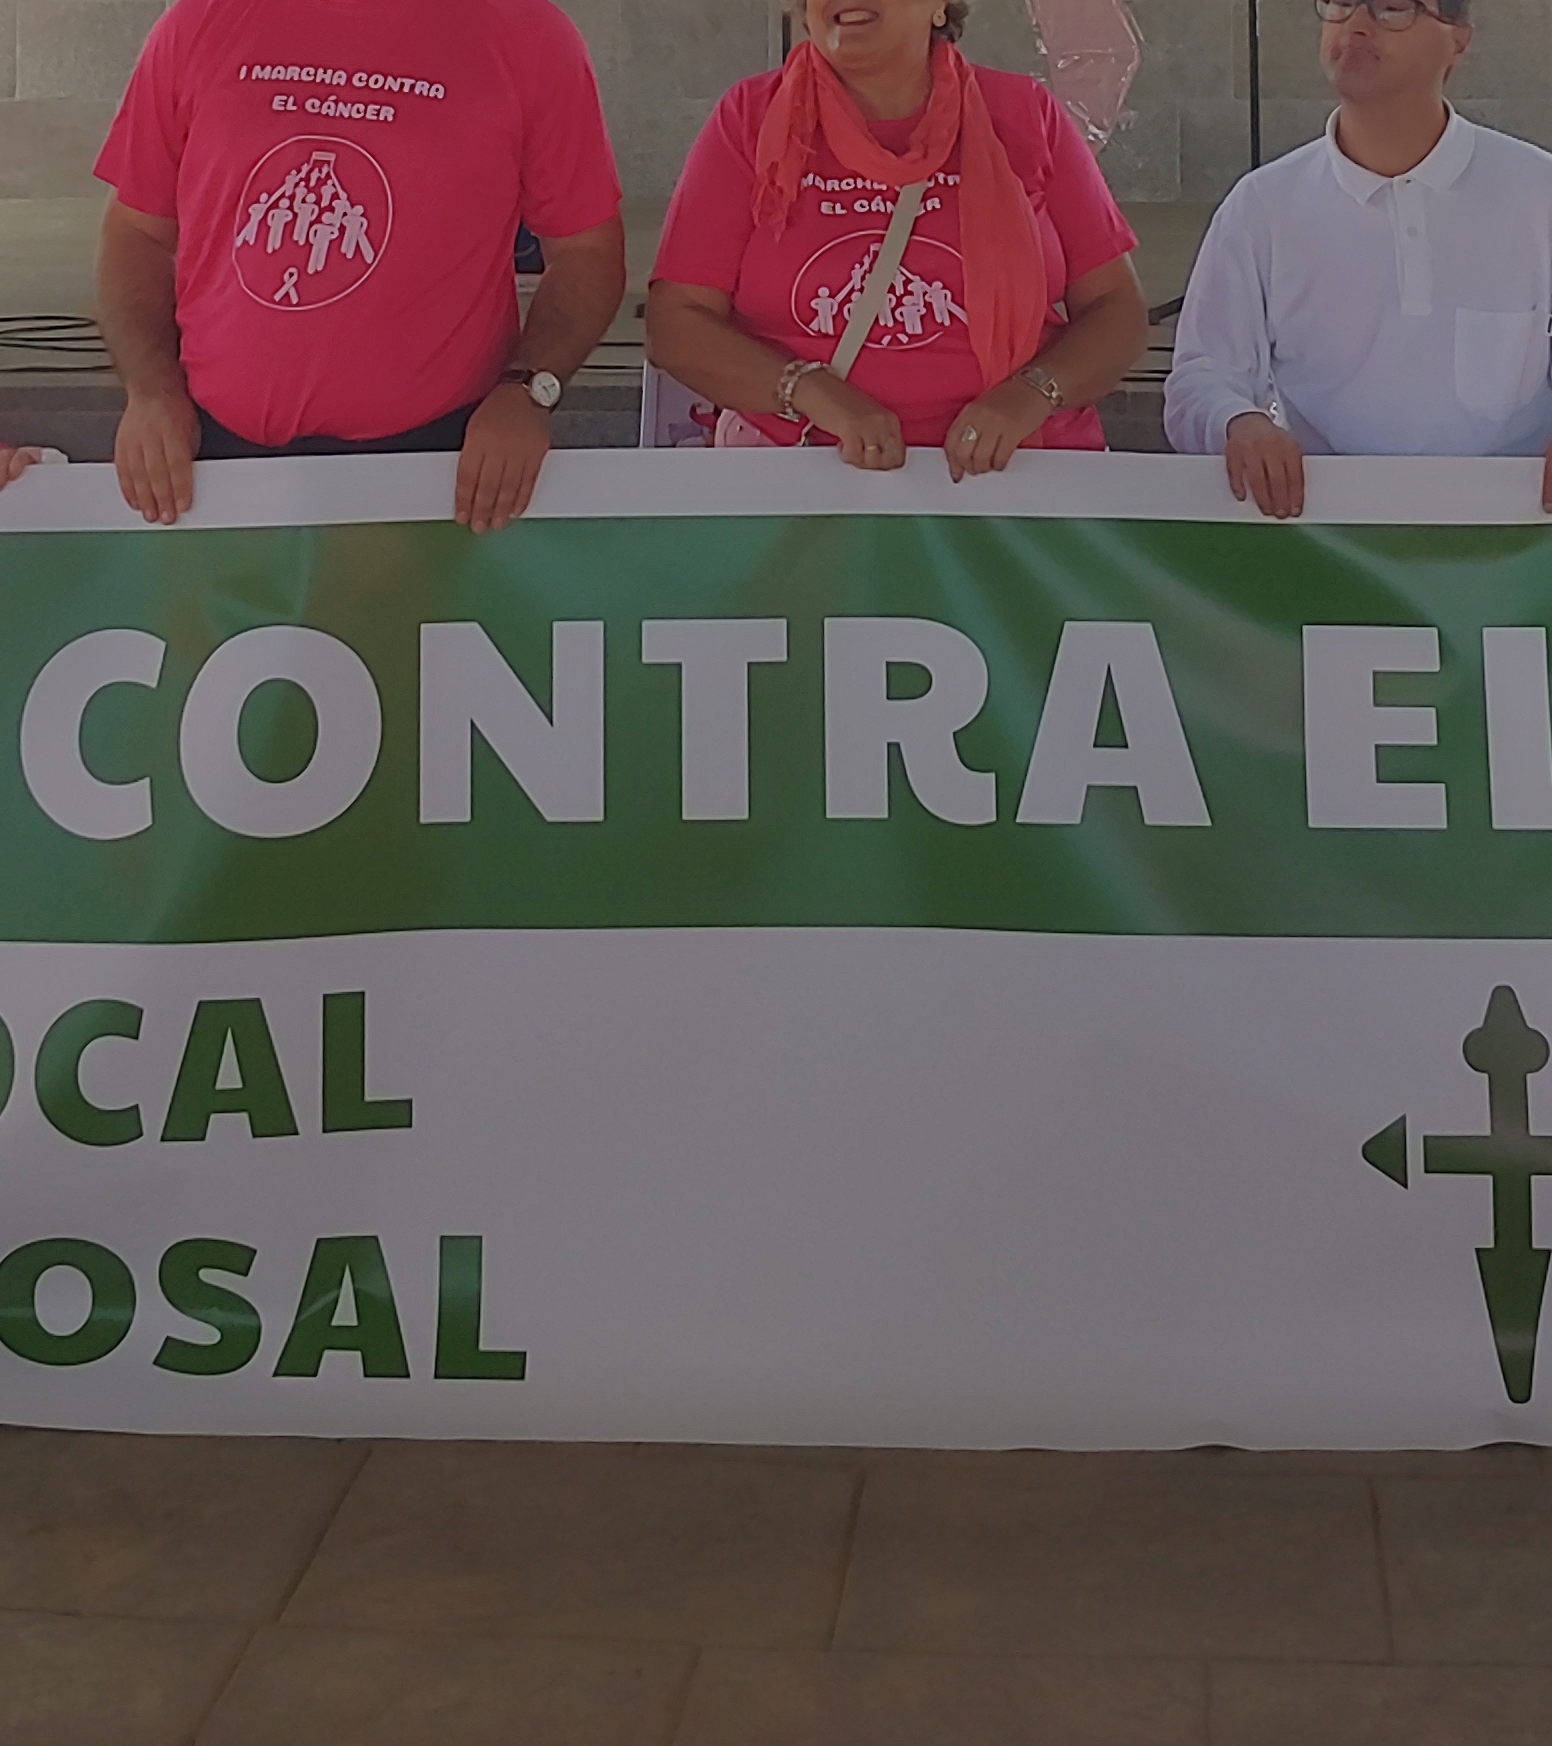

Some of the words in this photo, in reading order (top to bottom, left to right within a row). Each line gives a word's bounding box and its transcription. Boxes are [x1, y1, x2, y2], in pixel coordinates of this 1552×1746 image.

[239, 64, 248, 80] I
[251, 64, 347, 86] MARCHA
[352, 72, 445, 99] CONTRA
[271, 95, 298, 111] EL
[305, 95, 396, 122] CÁNCER
[819, 200, 848, 215] EL
[19, 615, 1213, 840] CONTRA
